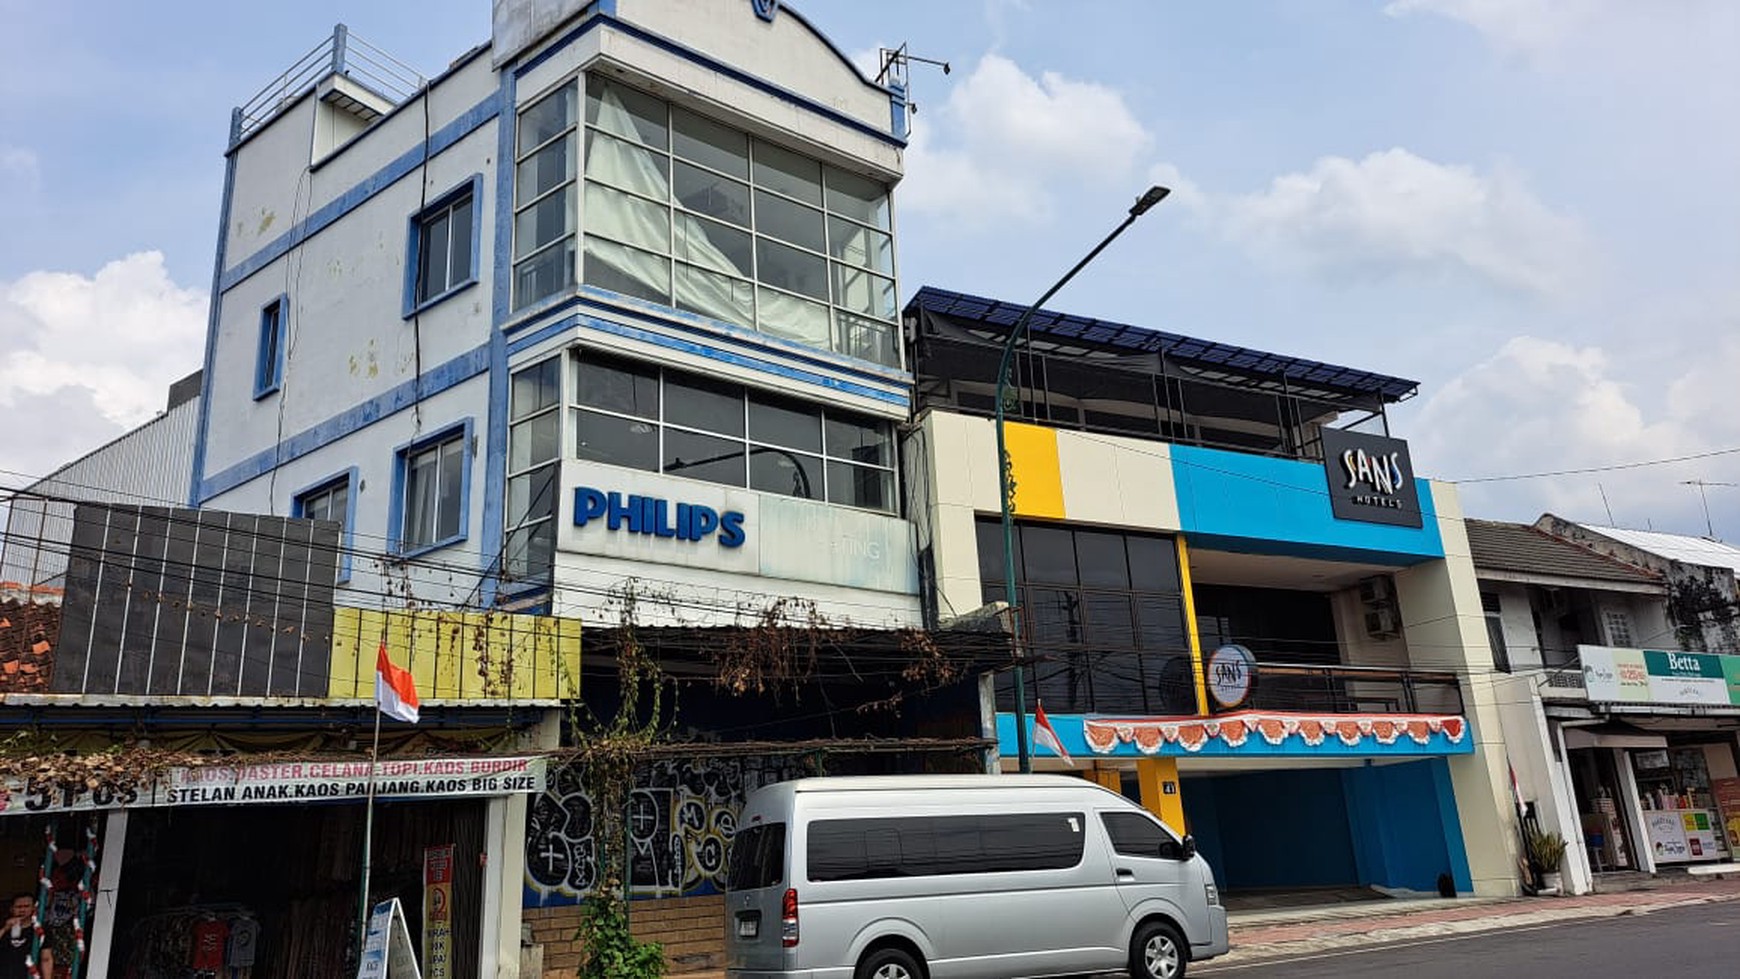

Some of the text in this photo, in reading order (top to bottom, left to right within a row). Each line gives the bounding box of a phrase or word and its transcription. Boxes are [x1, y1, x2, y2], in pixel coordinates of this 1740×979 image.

[1344, 448, 1403, 494] SANS
[1357, 494, 1403, 509] HOTELS
[573, 486, 746, 548] PHILIPS
[1667, 652, 1701, 671] Betta
[167, 786, 236, 803] STELAN
[472, 778, 498, 791] BIG
[503, 776, 535, 790] SIZE
